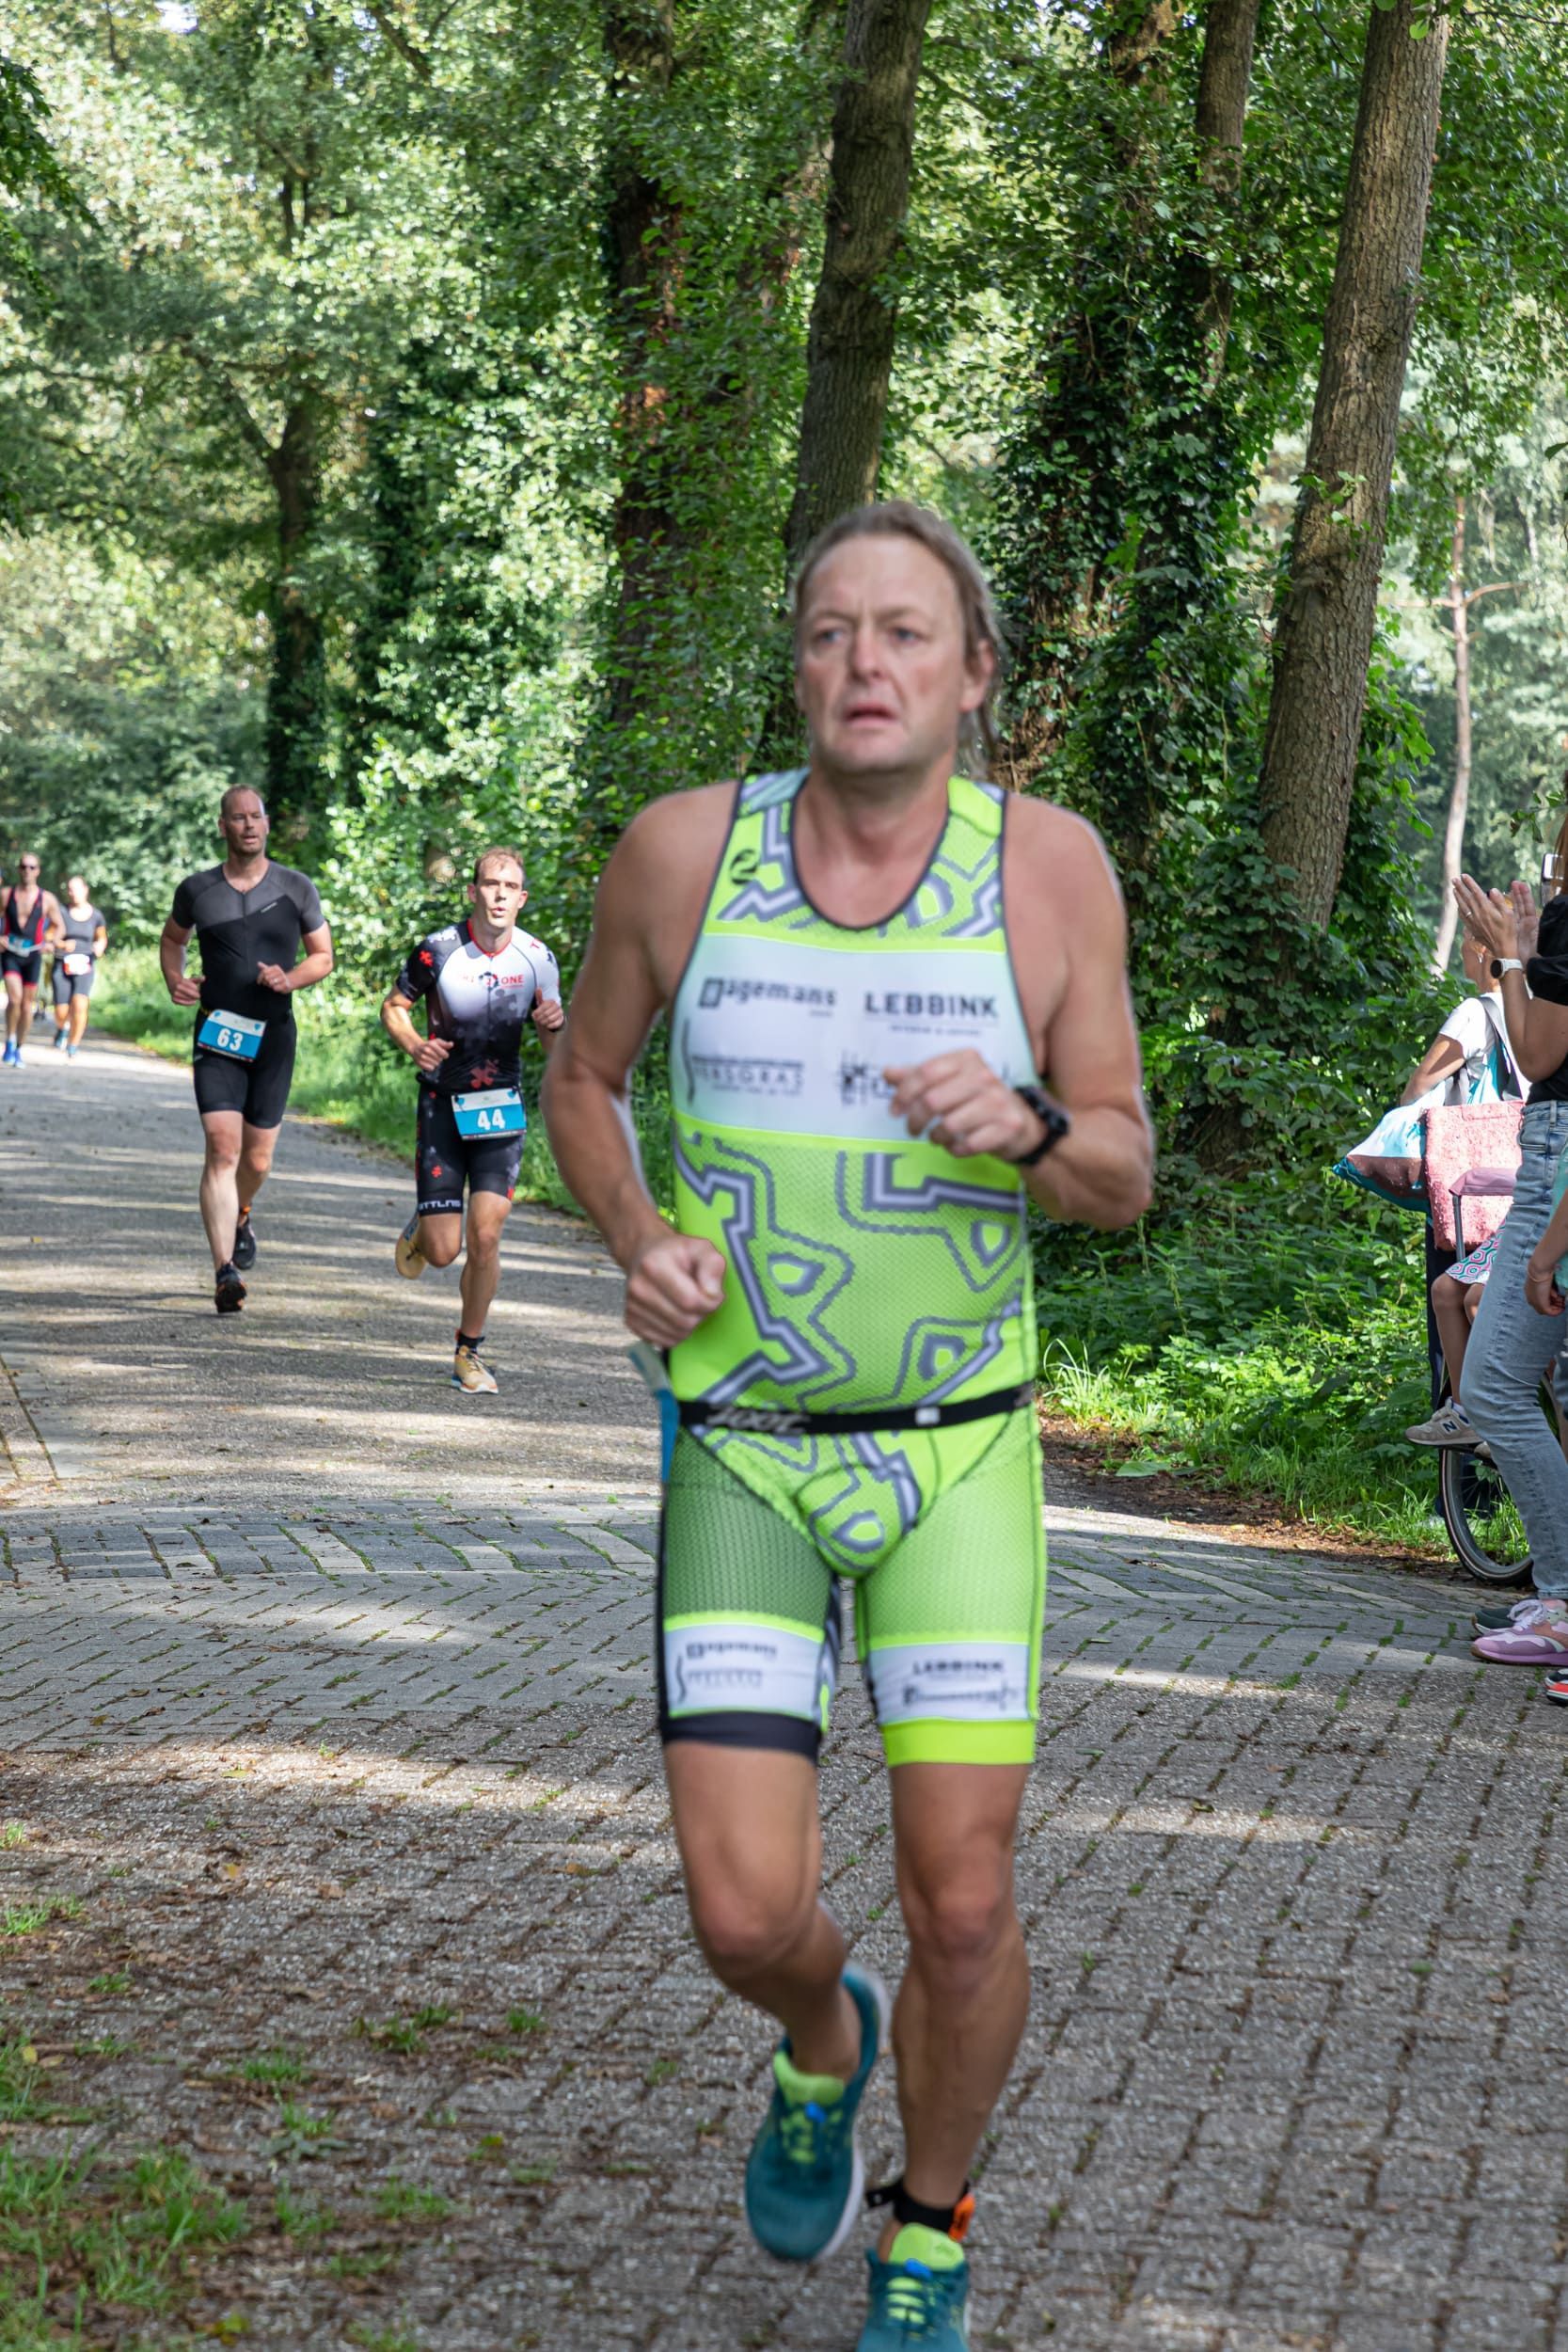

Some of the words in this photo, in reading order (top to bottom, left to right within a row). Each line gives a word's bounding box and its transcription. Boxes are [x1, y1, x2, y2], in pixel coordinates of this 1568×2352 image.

[501, 974, 525, 986] ONE
[864, 991, 998, 1018] LEBBINK
[216, 1027, 244, 1052] 63
[477, 1108, 506, 1131] 44
[1442, 1420, 1458, 1433] N
